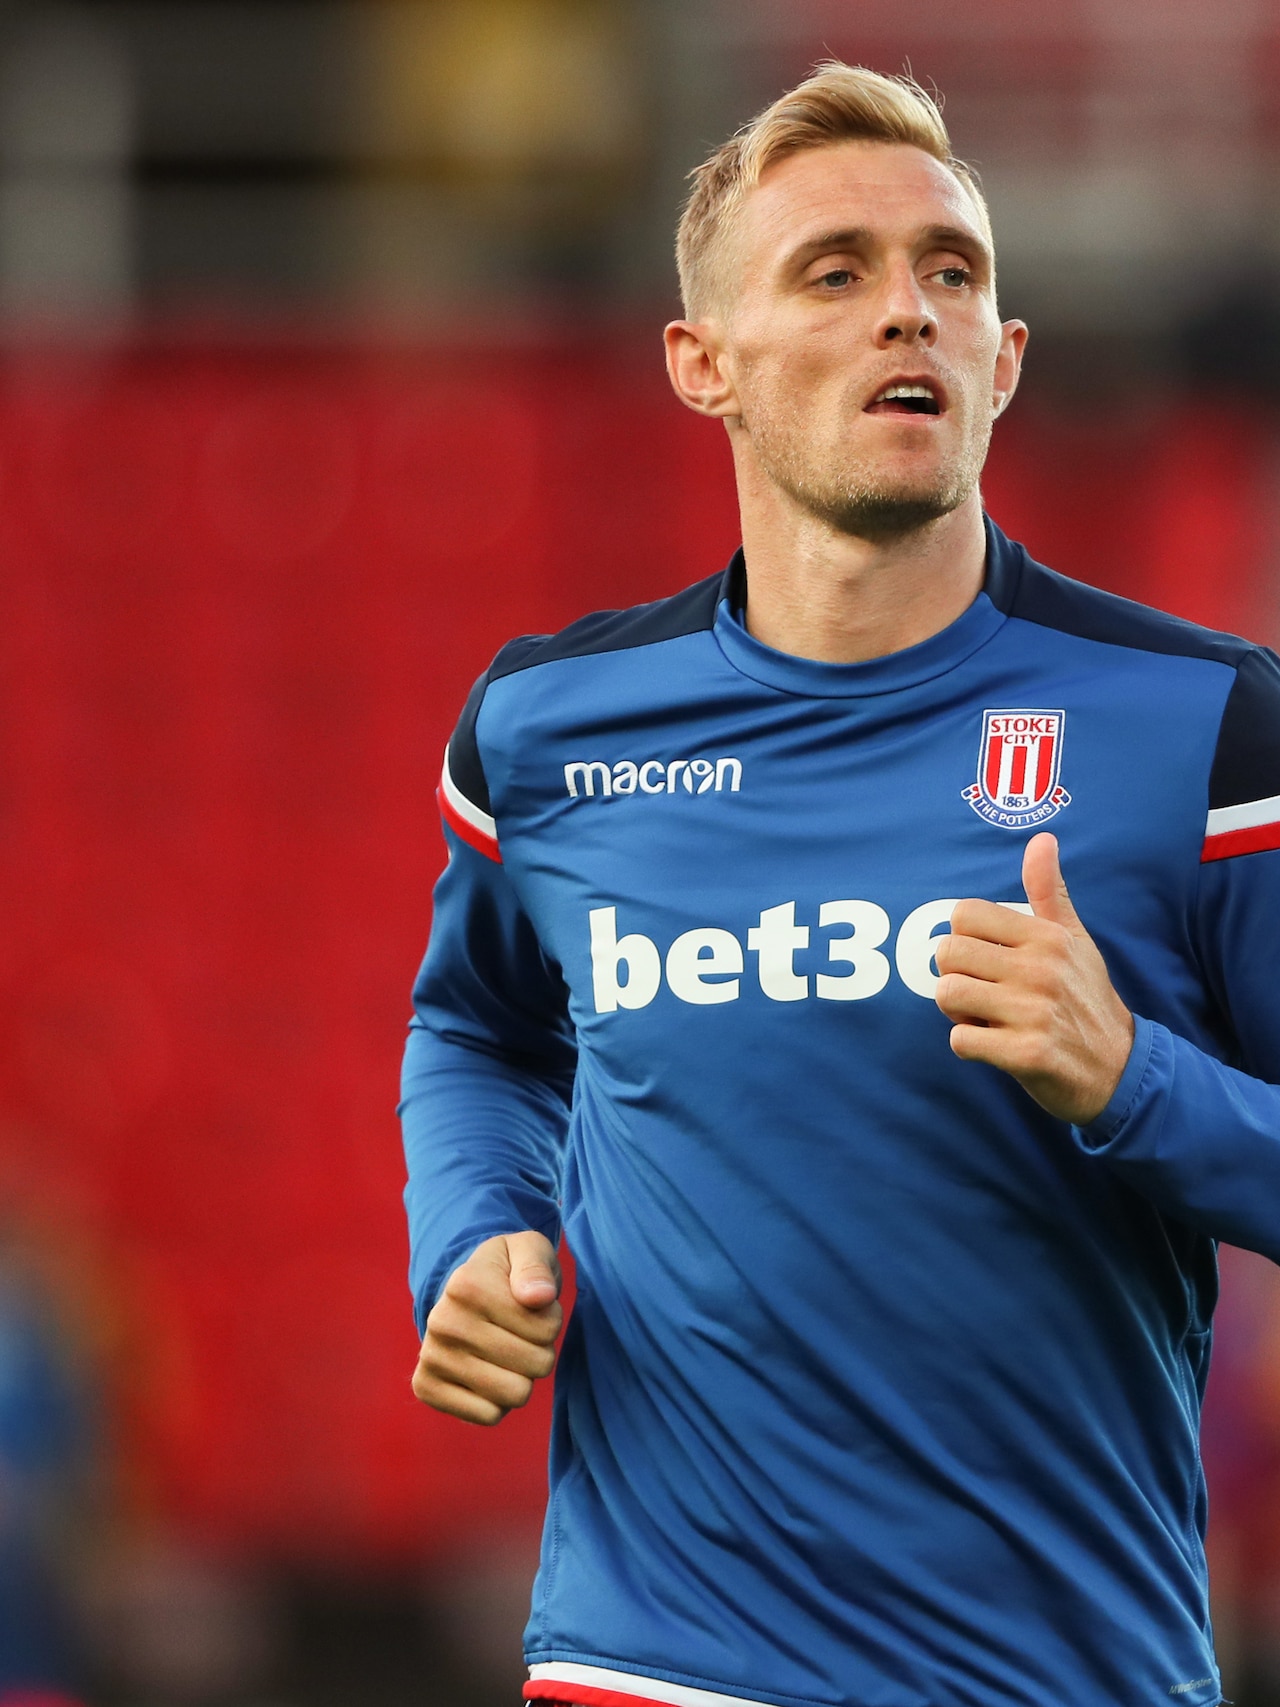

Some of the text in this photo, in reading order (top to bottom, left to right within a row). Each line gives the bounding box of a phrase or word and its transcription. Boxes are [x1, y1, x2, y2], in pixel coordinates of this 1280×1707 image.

[991, 718, 1055, 733] STOKE
[1004, 734, 1038, 744] CITY
[564, 757, 742, 798] macron
[1002, 795, 1029, 808] 1863
[977, 799, 1053, 825] THE POTTERS
[590, 899, 1034, 1013] bet36
